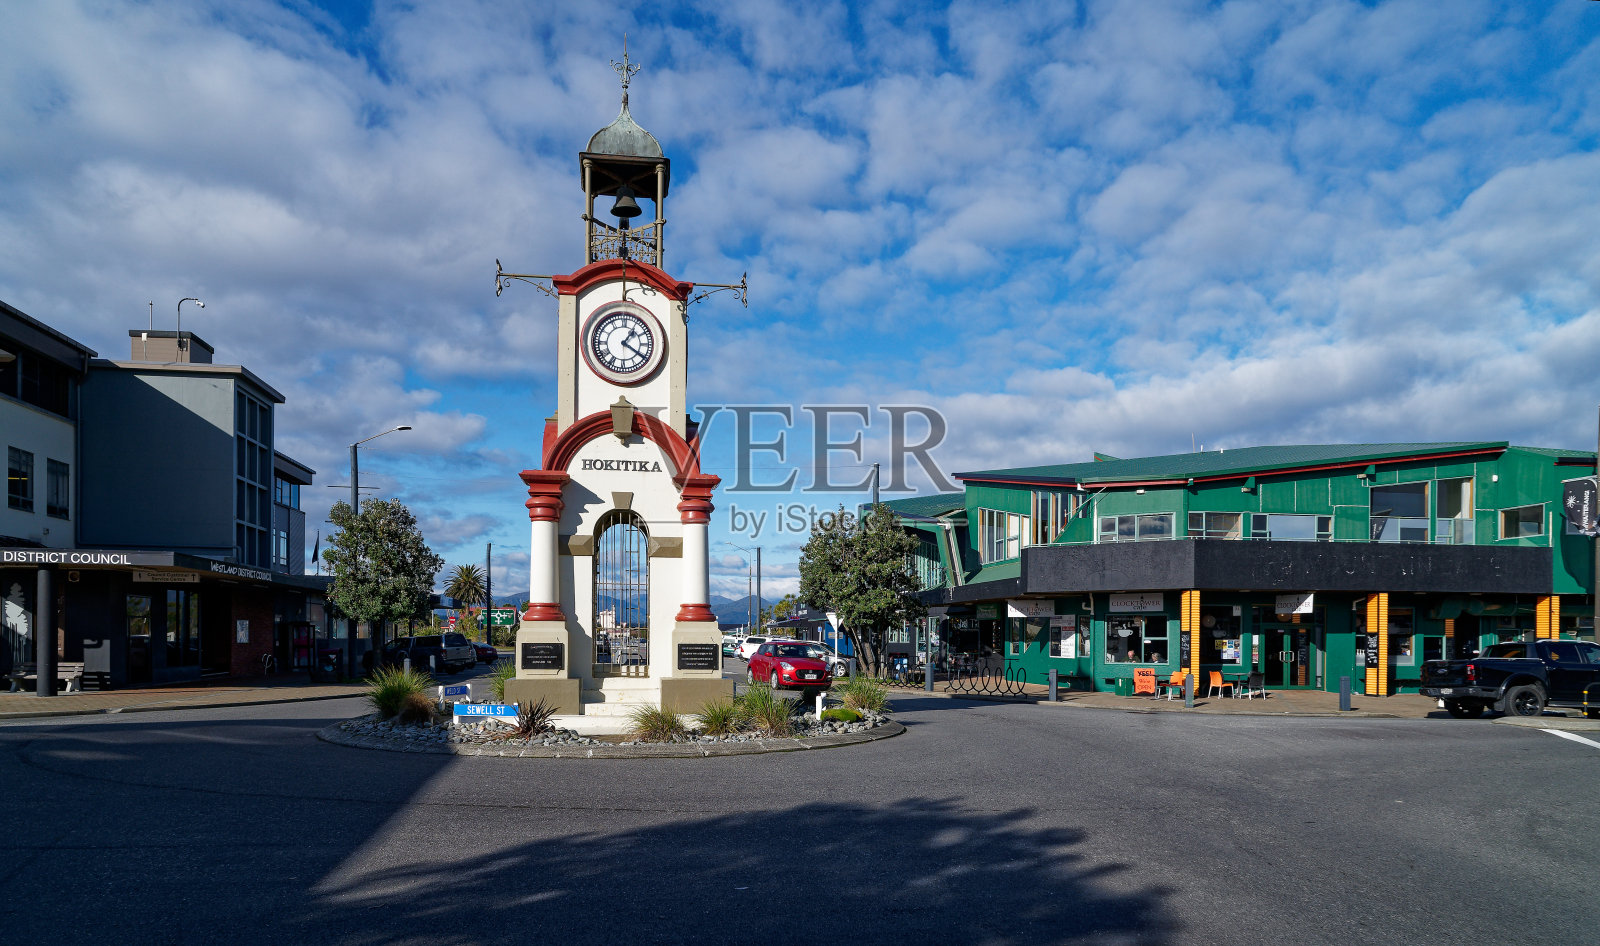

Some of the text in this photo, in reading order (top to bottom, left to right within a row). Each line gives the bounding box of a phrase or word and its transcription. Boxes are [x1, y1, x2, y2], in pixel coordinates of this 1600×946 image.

[581, 459, 662, 473] HOKITIKA
[3, 551, 132, 565] DISTRICT COUNCIL
[210, 561, 273, 582] WESTLAND DISTRICT COUNCIL
[466, 705, 505, 715] SEWELL ST
